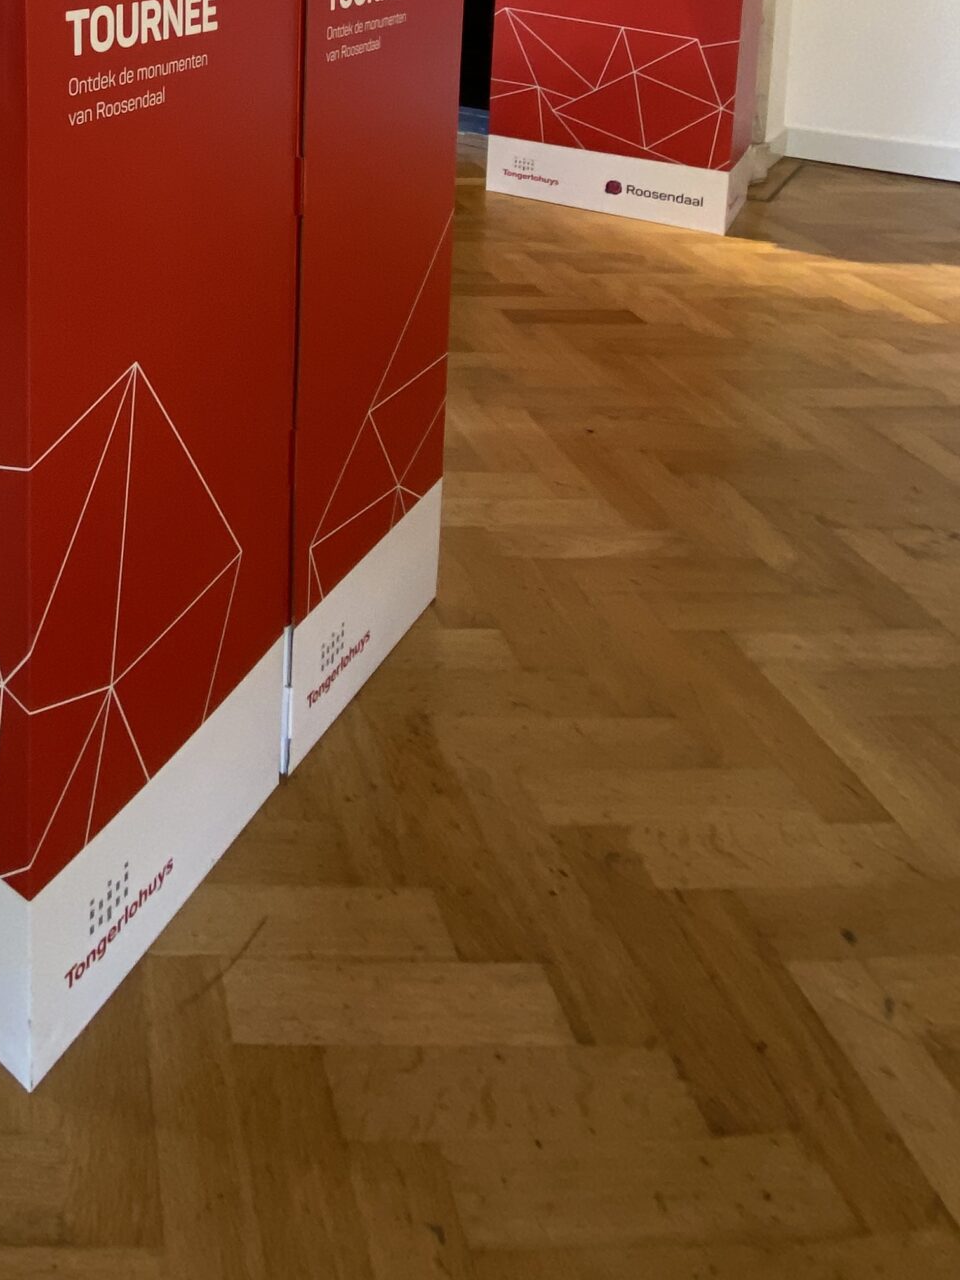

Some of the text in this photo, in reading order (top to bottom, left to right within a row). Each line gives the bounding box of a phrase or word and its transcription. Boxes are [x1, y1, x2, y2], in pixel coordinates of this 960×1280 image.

[326, 12, 407, 40] Ontdek de monumenten
[325, 36, 381, 62] van Roosendaal
[68, 53, 208, 97] Ontdek de monumenten
[68, 86, 166, 126] van Roosendaal
[502, 168, 559, 187] Tongerlohuys
[626, 184, 704, 207] Roosendaal
[306, 630, 371, 709] Tongerlohuys
[64, 857, 175, 990] Tongerlohuys
